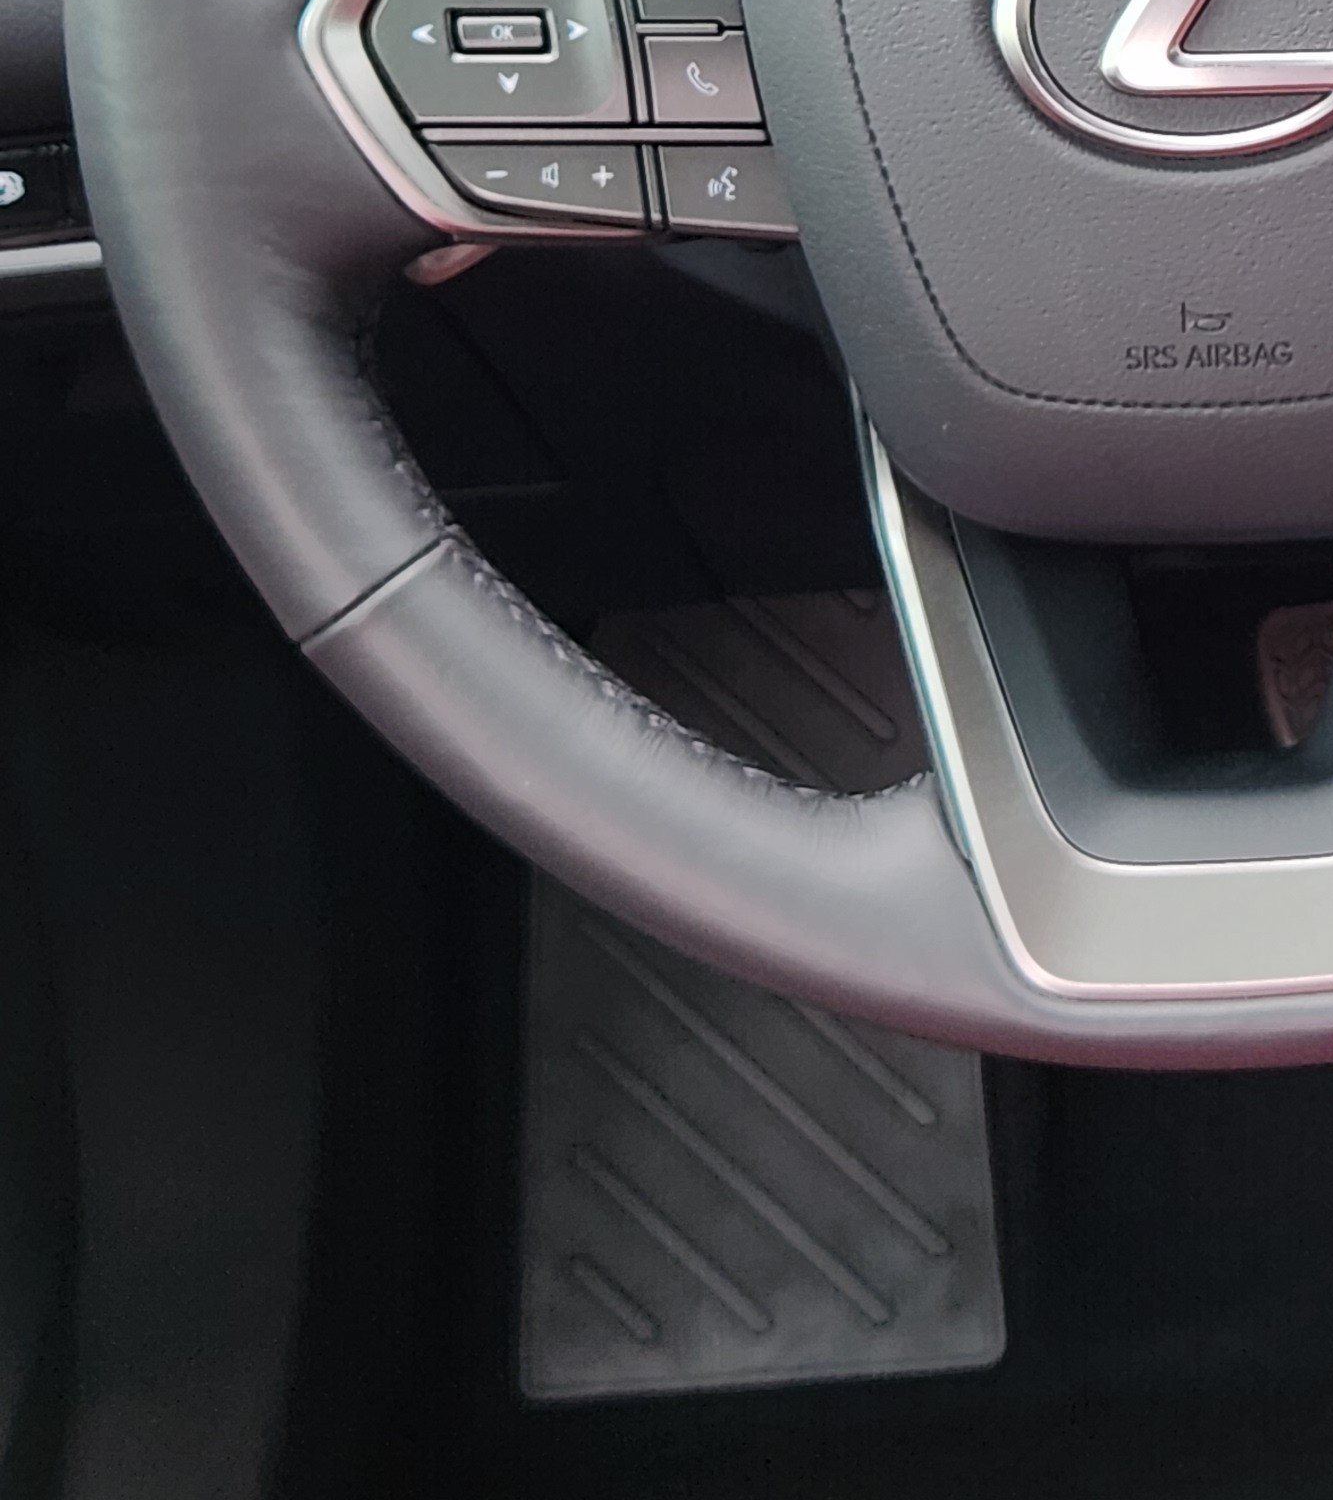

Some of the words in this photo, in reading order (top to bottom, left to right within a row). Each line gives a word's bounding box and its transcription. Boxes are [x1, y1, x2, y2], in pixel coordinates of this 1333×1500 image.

[490, 24, 514, 41] OK
[1125, 345, 1178, 371] SRS
[1184, 341, 1293, 370] AIRBAG
